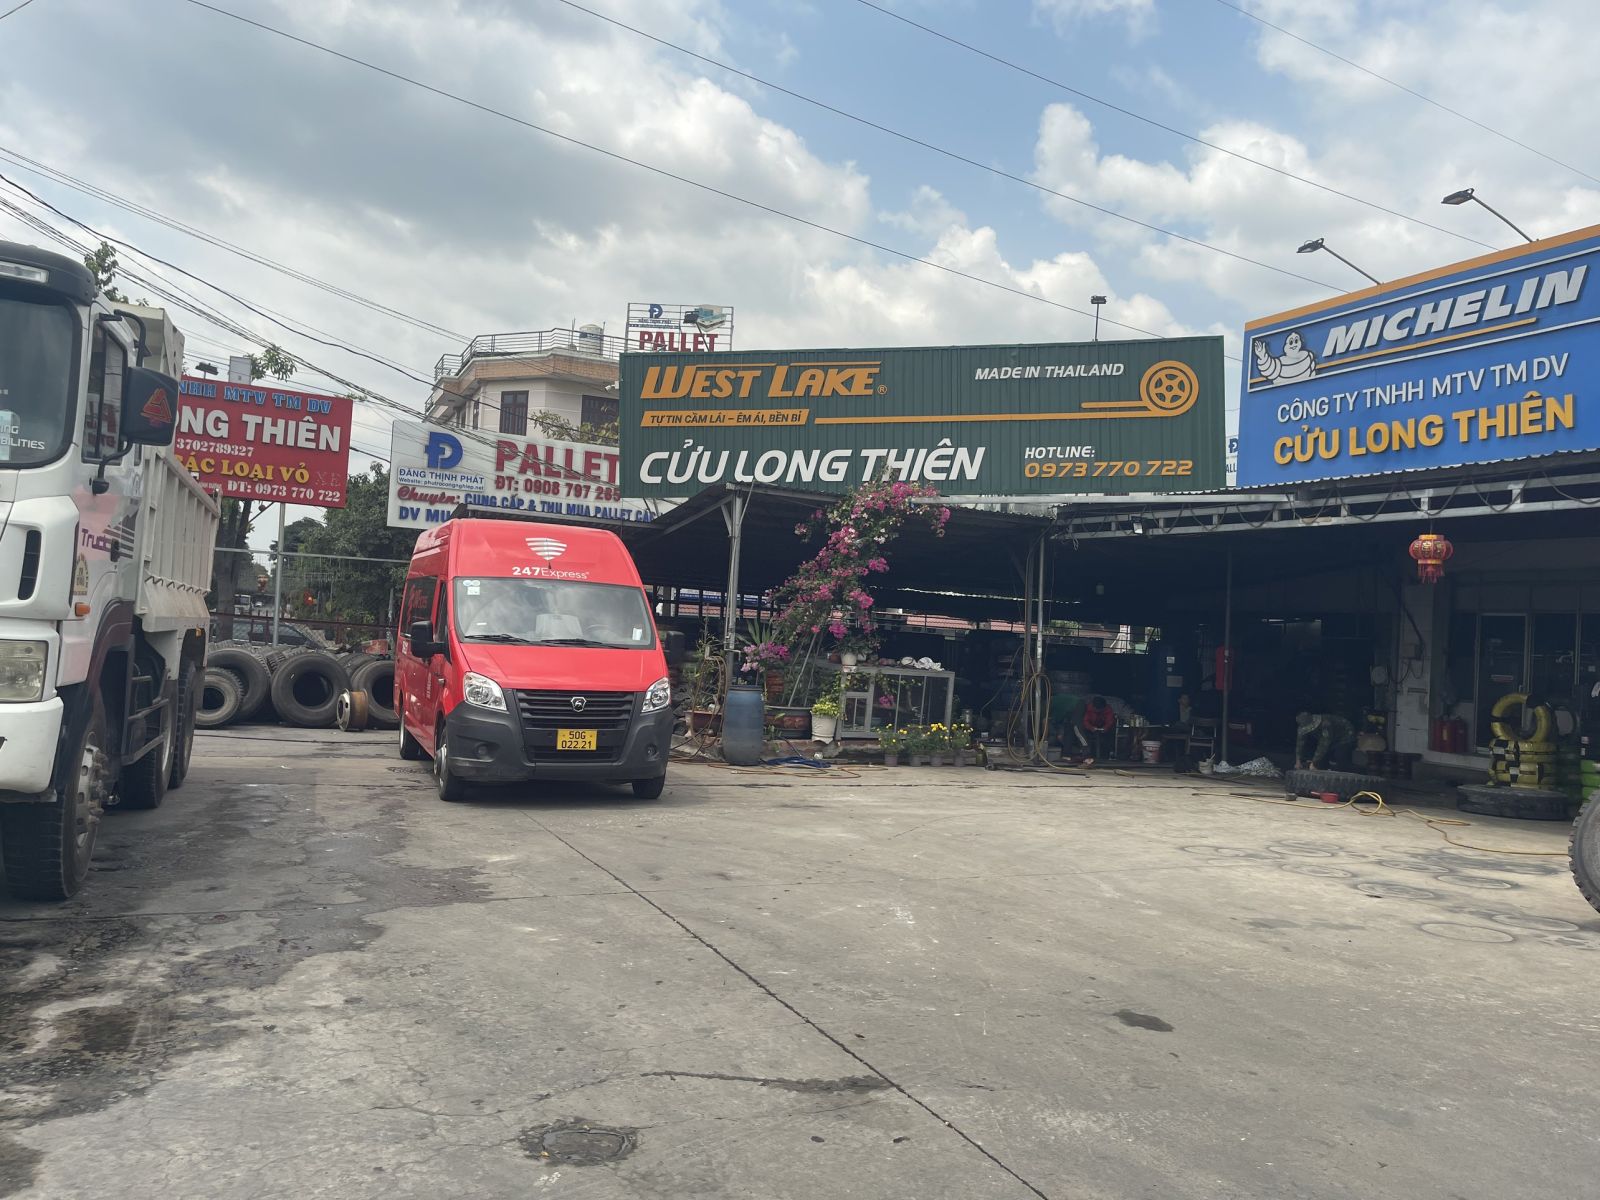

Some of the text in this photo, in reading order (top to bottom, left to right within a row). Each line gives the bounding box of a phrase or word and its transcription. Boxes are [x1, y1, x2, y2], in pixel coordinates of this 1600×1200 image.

[1322, 265, 1587, 358] MICHELIN
[639, 331, 718, 352] PALLET
[640, 364, 762, 399] WEST
[767, 365, 880, 398] LAKE
[975, 363, 1125, 381] MADE IN THAILAND
[1277, 353, 1569, 423] CÔNG TY TNHH MTV TM DV
[224, 387, 267, 405] MTV
[272, 394, 302, 410] TM
[307, 399, 332, 415] DV
[175, 405, 341, 452] NG THIÊN
[666, 414, 683, 424] TIN
[709, 411, 726, 423] LÁI
[1274, 390, 1575, 465] CỬU LONG THIÊN
[495, 440, 619, 485] PALLET
[639, 438, 986, 484] CỬU LONG THIÊN
[1025, 446, 1096, 459] HOTLINE:
[220, 459, 274, 481] LOẠI
[280, 461, 310, 484] VỎ
[429, 471, 460, 483] THỊNH
[460, 473, 485, 484] PHÁT
[1024, 460, 1193, 478] 0973 770 722
[255, 482, 287, 497] 0973
[291, 487, 314, 500] 770
[319, 490, 341, 502] 722
[495, 475, 518, 491] ĐT:
[523, 479, 560, 496] 0908
[565, 483, 592, 499] 797
[399, 506, 420, 520] DV
[464, 493, 498, 507] CUNG
[528, 499, 537, 511] &
[540, 500, 562, 515] THU
[566, 502, 590, 517] MUA
[595, 506, 633, 521] PALLET
[561, 740, 592, 749] 022.21
[569, 731, 586, 740] 50G
